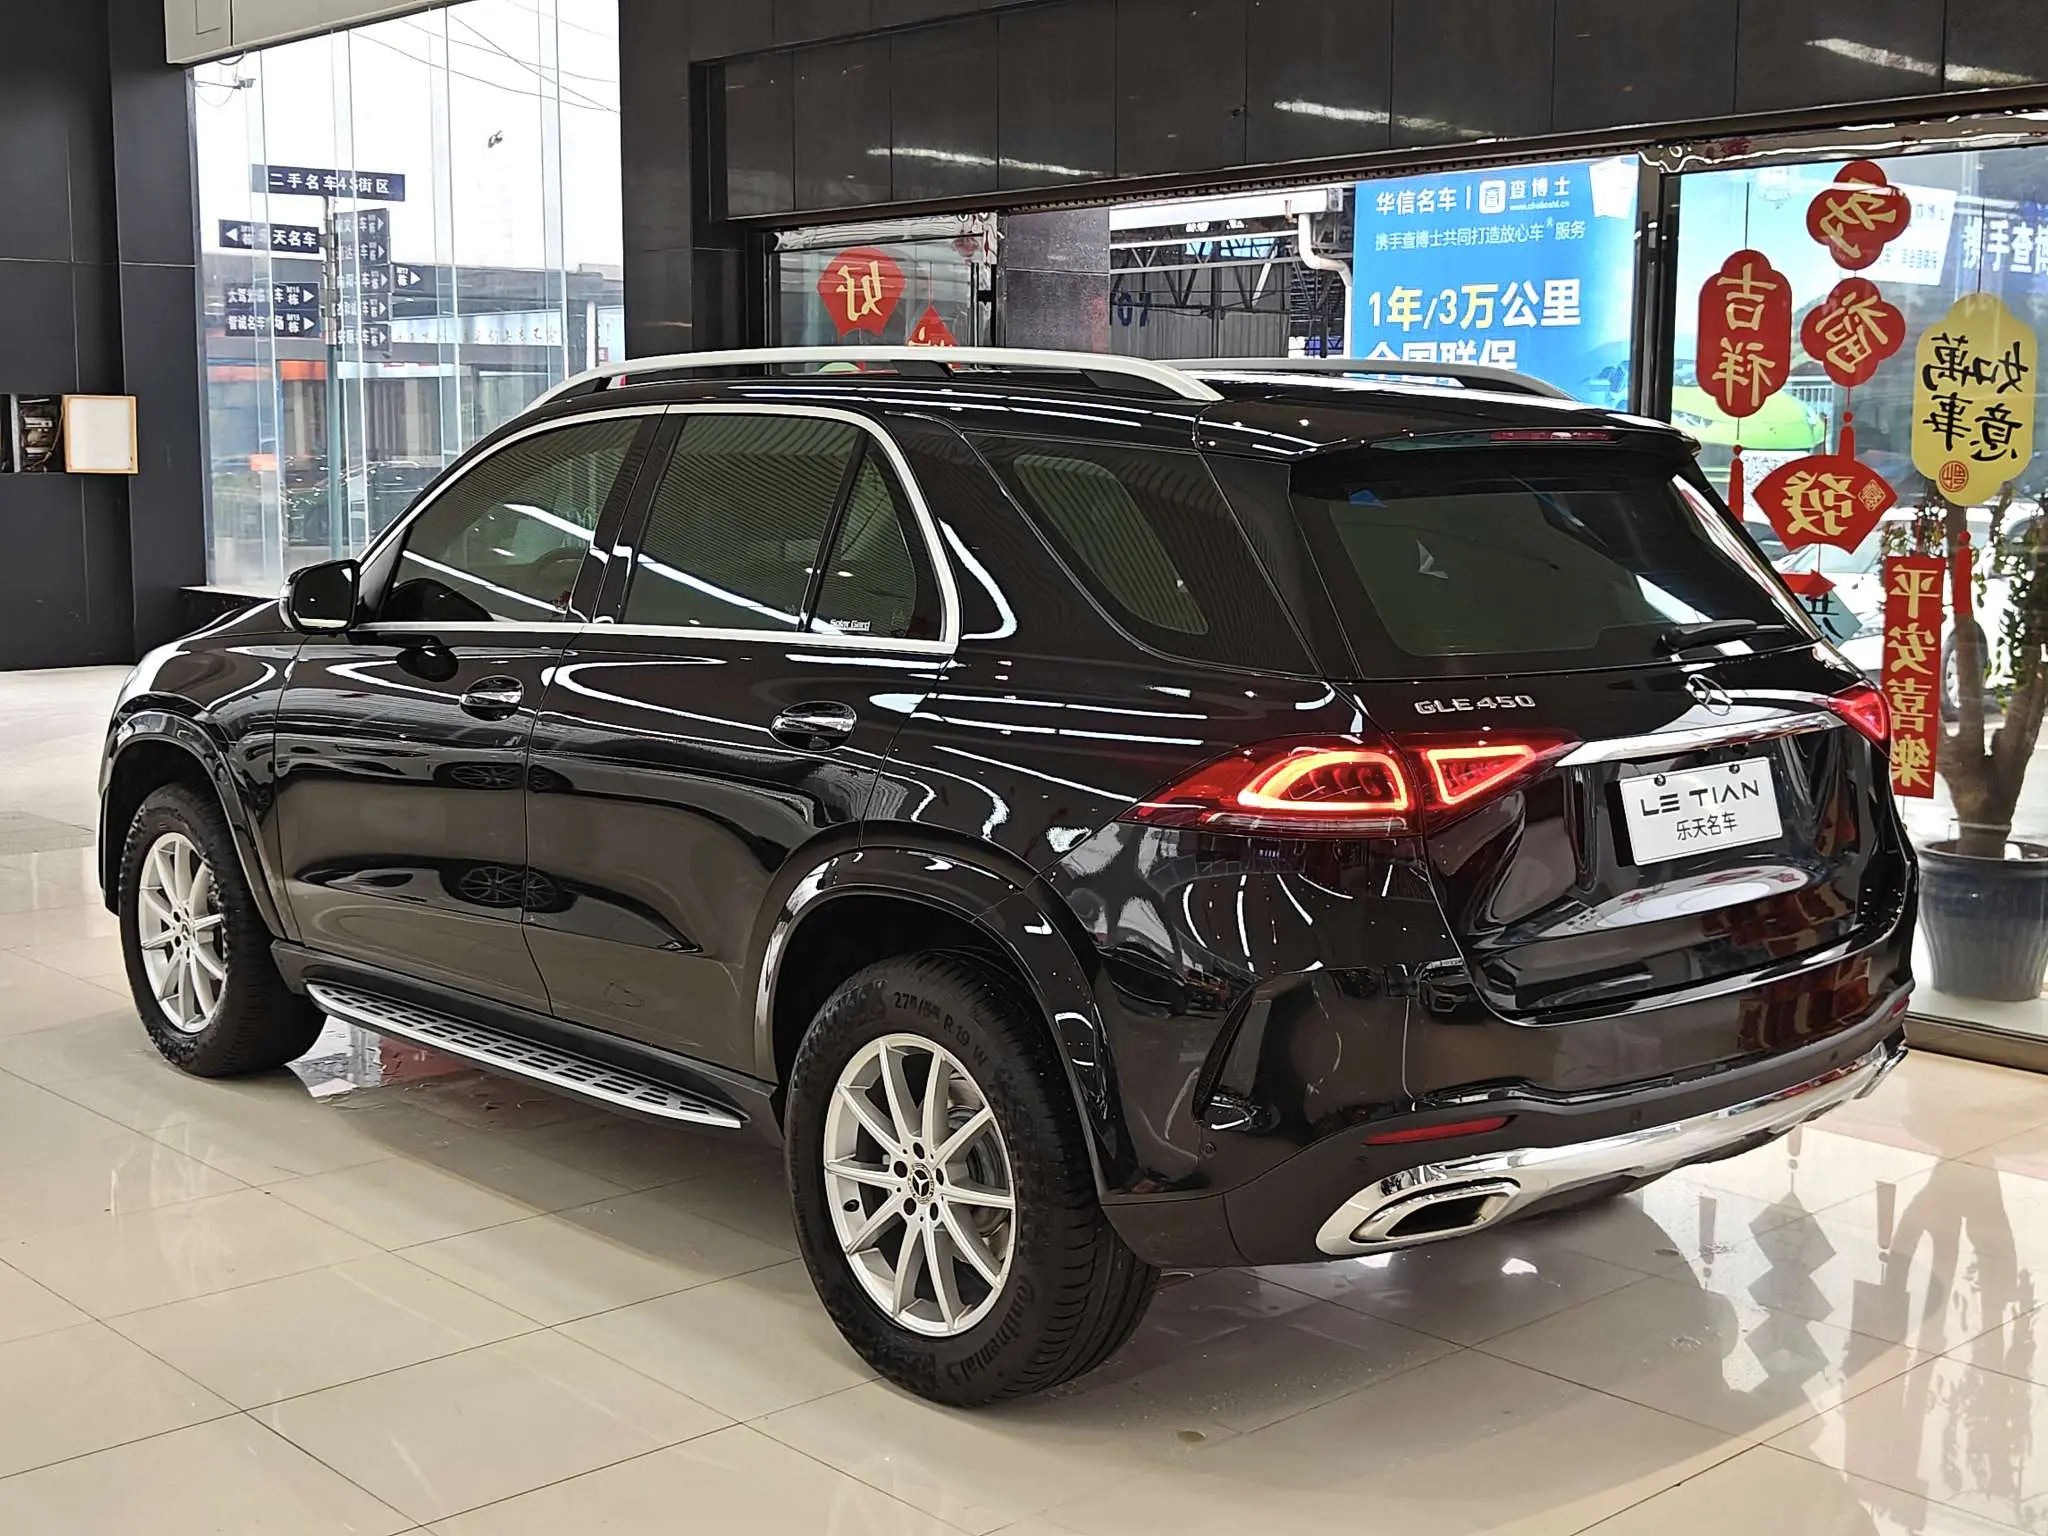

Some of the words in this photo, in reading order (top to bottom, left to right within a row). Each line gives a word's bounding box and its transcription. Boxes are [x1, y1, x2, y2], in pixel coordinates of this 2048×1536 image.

[269, 173, 390, 194] 二手名车4S街区
[1375, 187, 1457, 216] 华信名车
[1368, 278, 1581, 332] 1年/3万公里
[1640, 793, 1680, 816] LE
[1689, 780, 1760, 806] TIAN
[1676, 811, 1738, 841] 乐天名车
